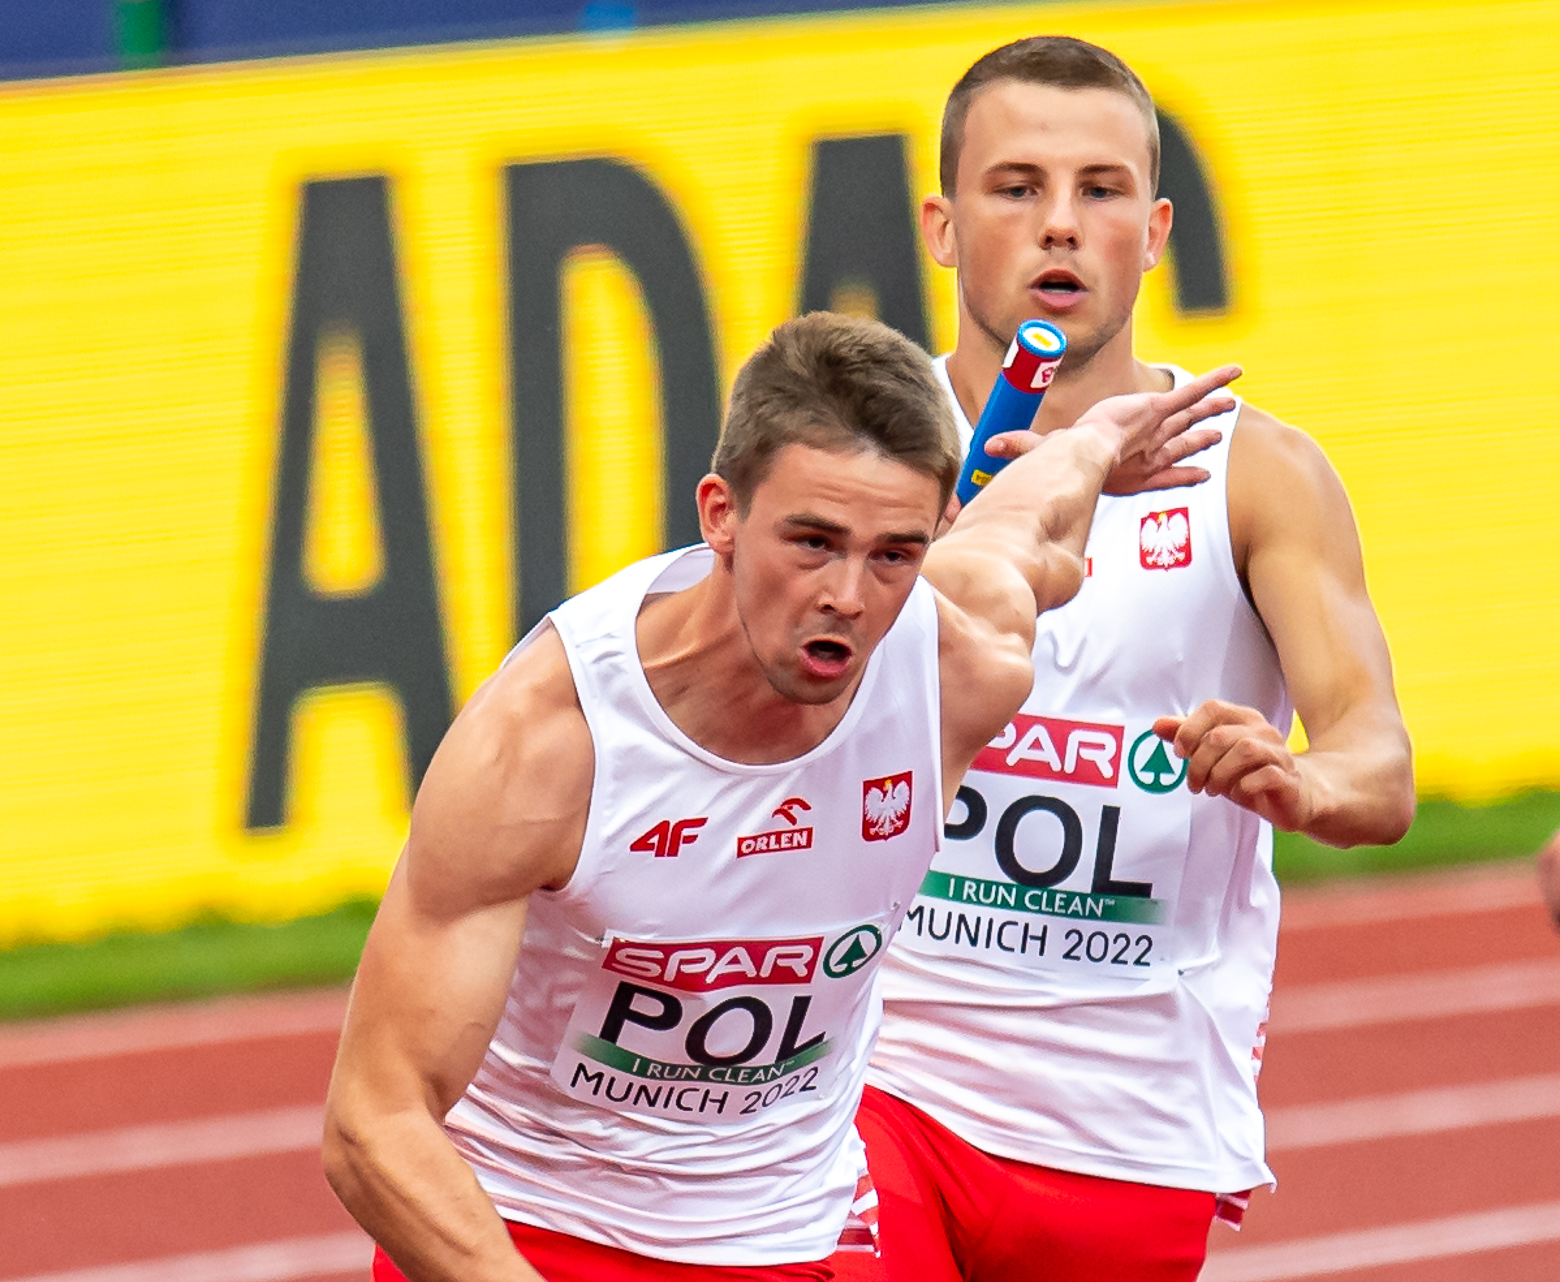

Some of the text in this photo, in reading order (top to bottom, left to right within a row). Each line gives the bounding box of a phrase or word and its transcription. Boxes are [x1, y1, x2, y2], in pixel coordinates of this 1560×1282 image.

[246, 102, 1228, 833] AD
[988, 721, 1118, 779] AR
[629, 816, 709, 858] 4F
[740, 829, 808, 855] ORLEN
[948, 878, 957, 897] I
[962, 881, 1018, 907] RUN
[614, 946, 814, 984] SPAR
[1061, 928, 1154, 967] 2022
[599, 980, 826, 1068] POL
[632, 1057, 641, 1073] I
[646, 1062, 701, 1080] RUN
[570, 1062, 819, 1116] MUNICH 2022
